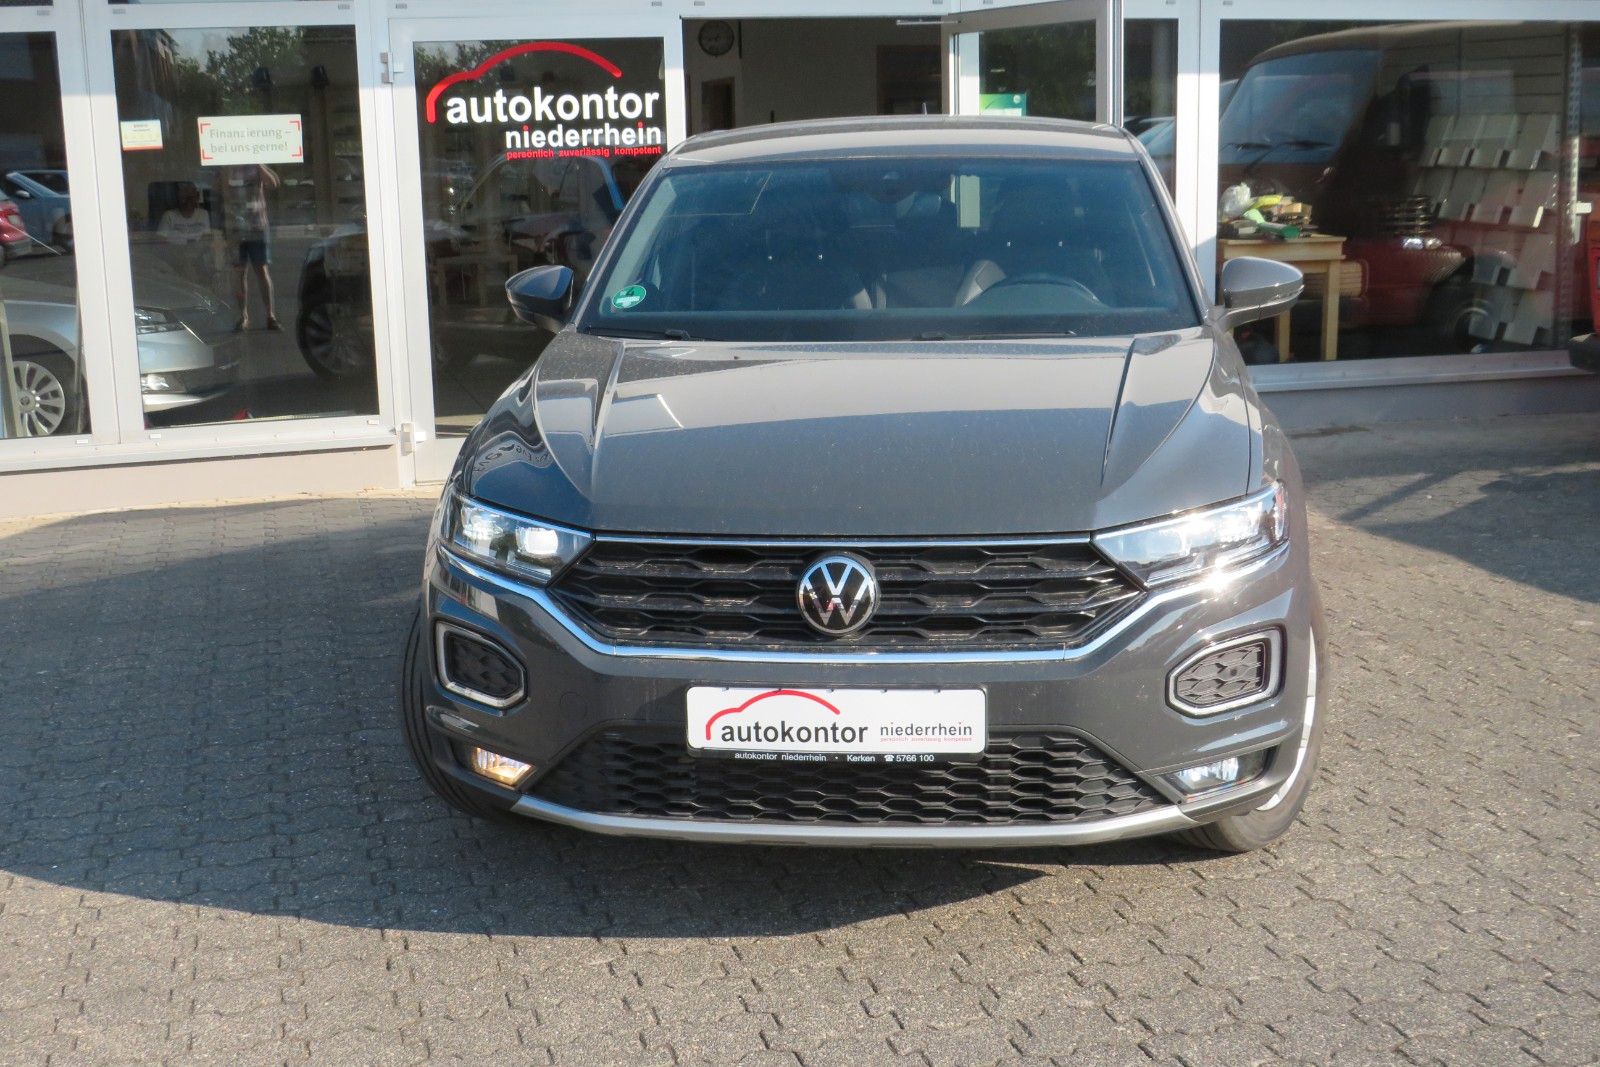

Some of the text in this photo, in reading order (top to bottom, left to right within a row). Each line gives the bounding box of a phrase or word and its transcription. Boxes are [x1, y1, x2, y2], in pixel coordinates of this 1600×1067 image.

[446, 86, 660, 124] autokontor
[209, 128, 283, 139] Finanzierung
[505, 121, 662, 149] niederrhein
[210, 142, 288, 154] bei uns gerne!
[506, 146, 661, 161] persönlich zuverlässig kompetent
[721, 720, 973, 743] autokontor niederrhein
[734, 752, 935, 762] autokontor niederrhein Kerken 5766 100
